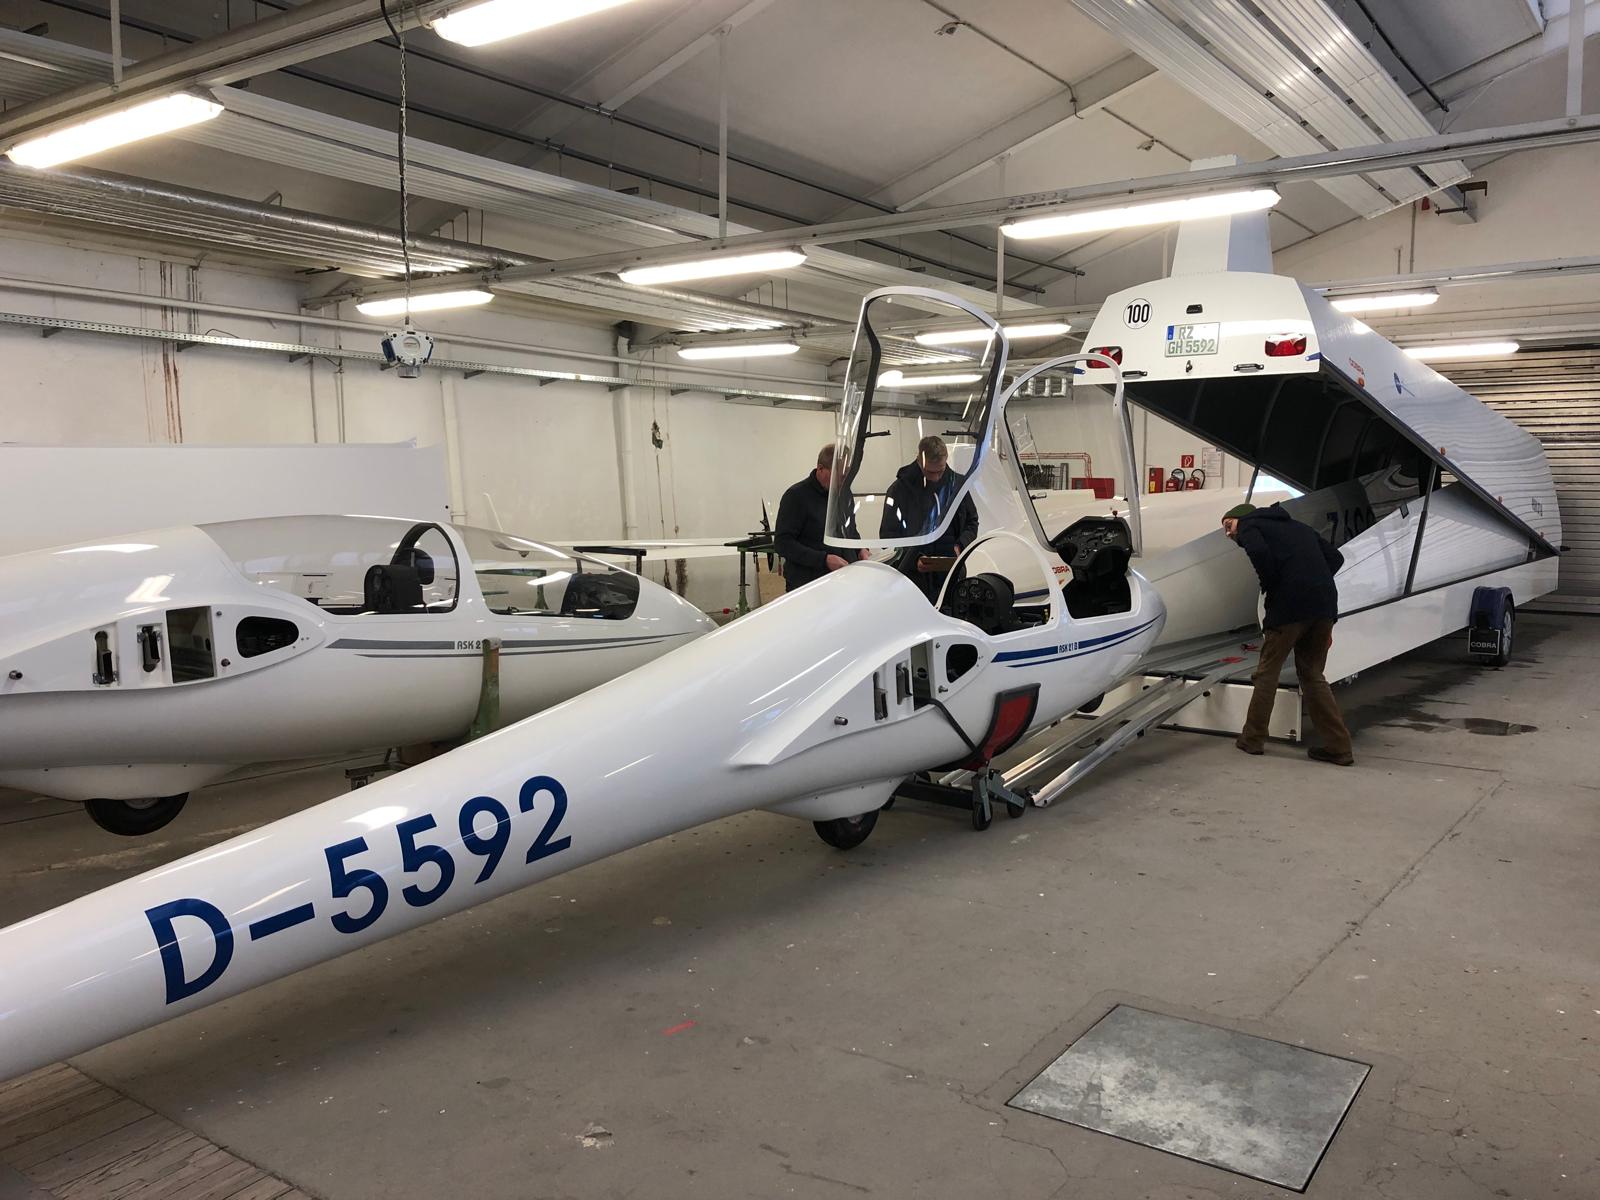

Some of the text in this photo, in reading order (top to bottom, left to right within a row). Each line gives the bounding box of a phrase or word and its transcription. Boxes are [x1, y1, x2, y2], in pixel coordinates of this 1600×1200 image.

[1127, 304, 1150, 324] 100
[1179, 326, 1194, 340] RZ
[1168, 338, 1215, 355] GH 5592
[1052, 565, 1070, 574] OBRA
[457, 640, 474, 650] ASK
[1470, 641, 1497, 649] COBRA
[144, 775, 572, 1005] D-5592
